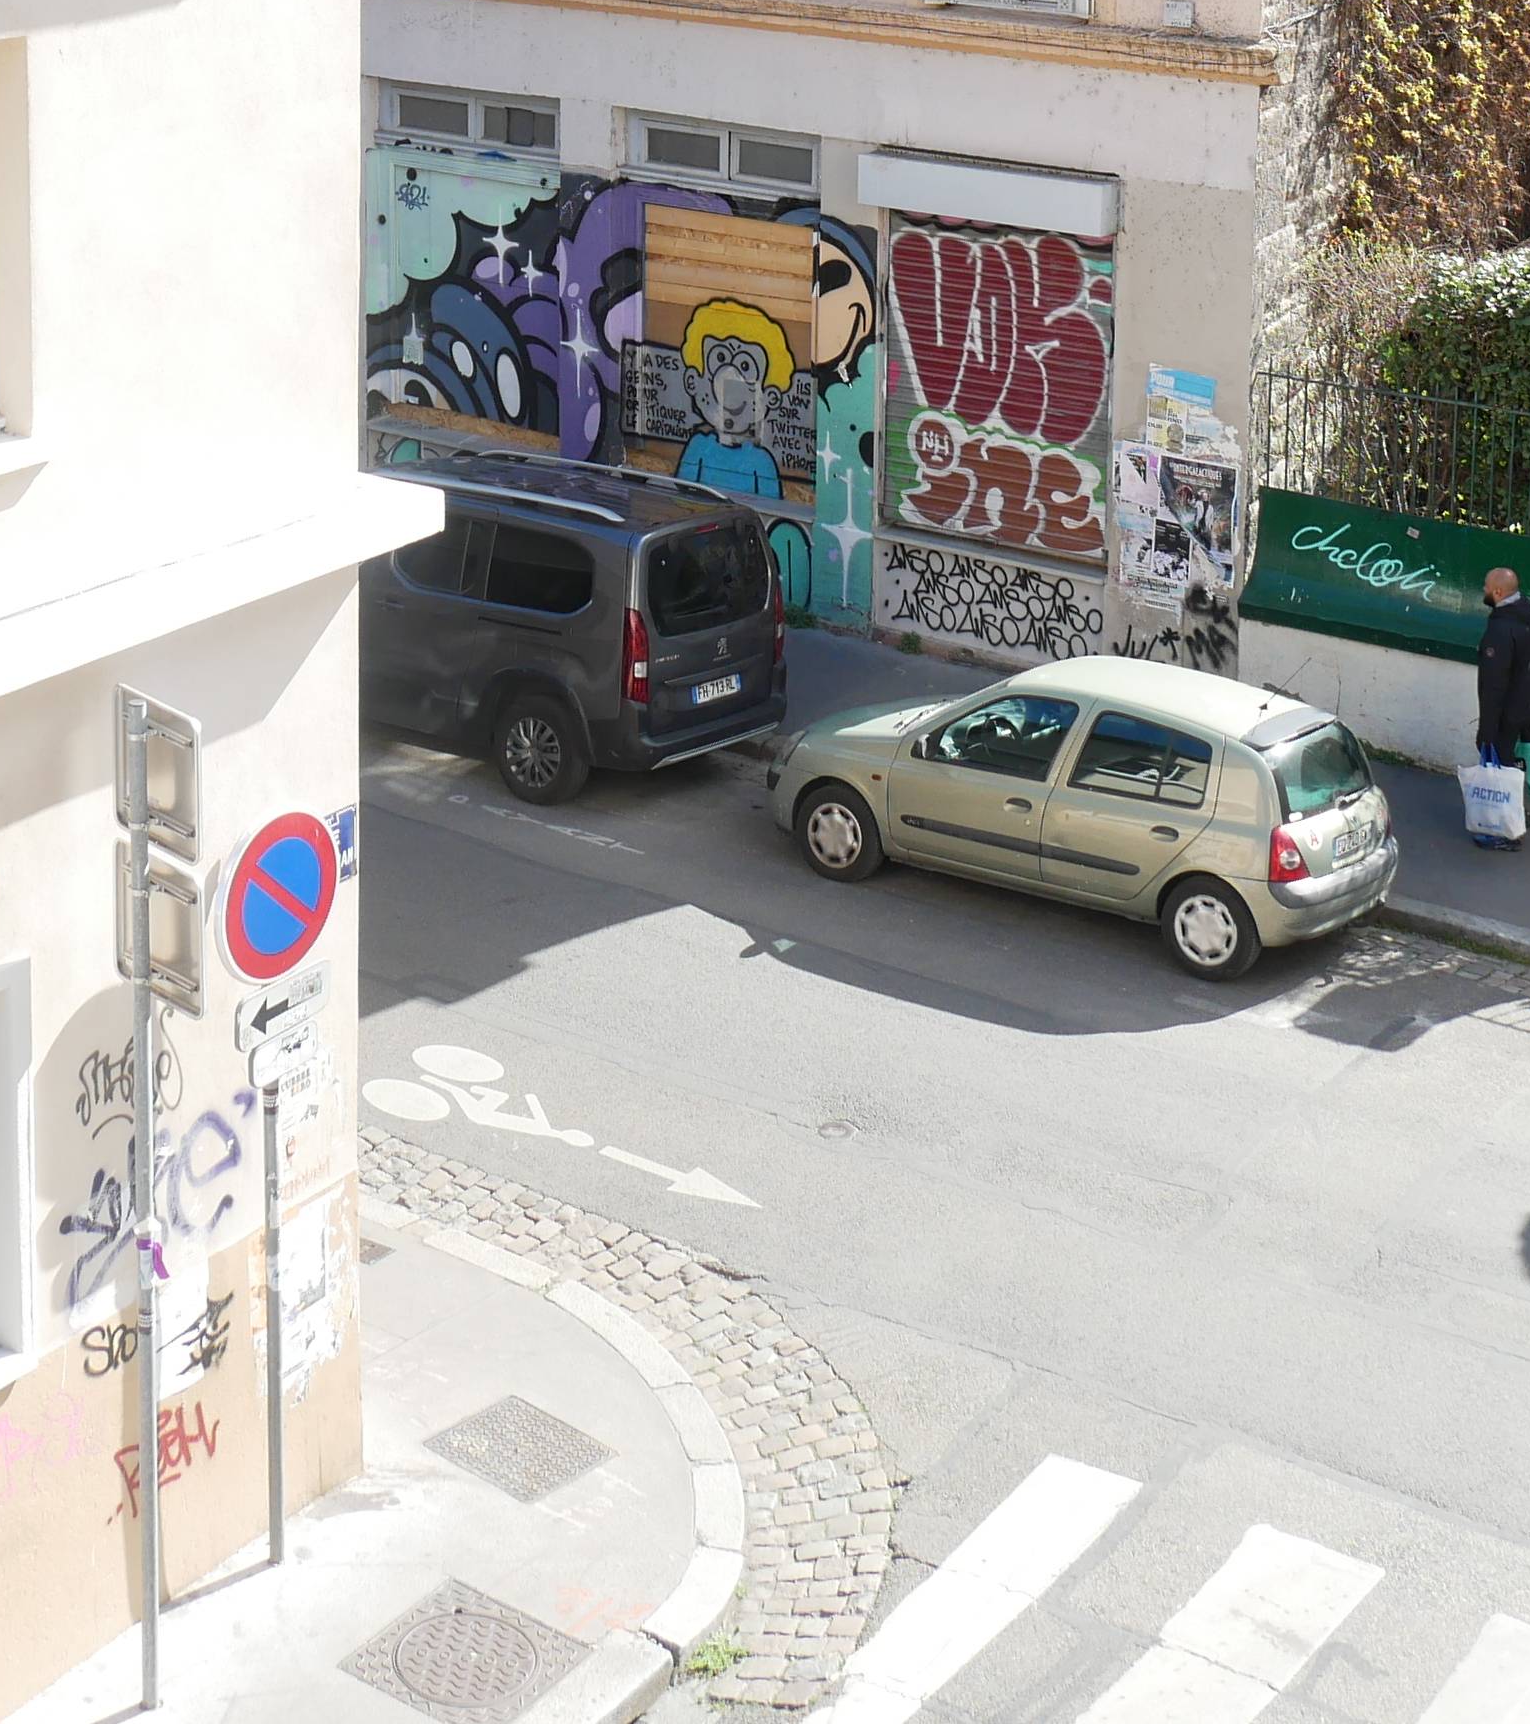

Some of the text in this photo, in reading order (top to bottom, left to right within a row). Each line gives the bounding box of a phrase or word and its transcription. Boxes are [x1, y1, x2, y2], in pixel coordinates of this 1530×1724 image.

[644, 354, 653, 368] A
[655, 355, 679, 371] DES
[779, 407, 801, 420] SUR
[772, 436, 801, 450] AVEC
[1471, 786, 1511, 804] ACTION
